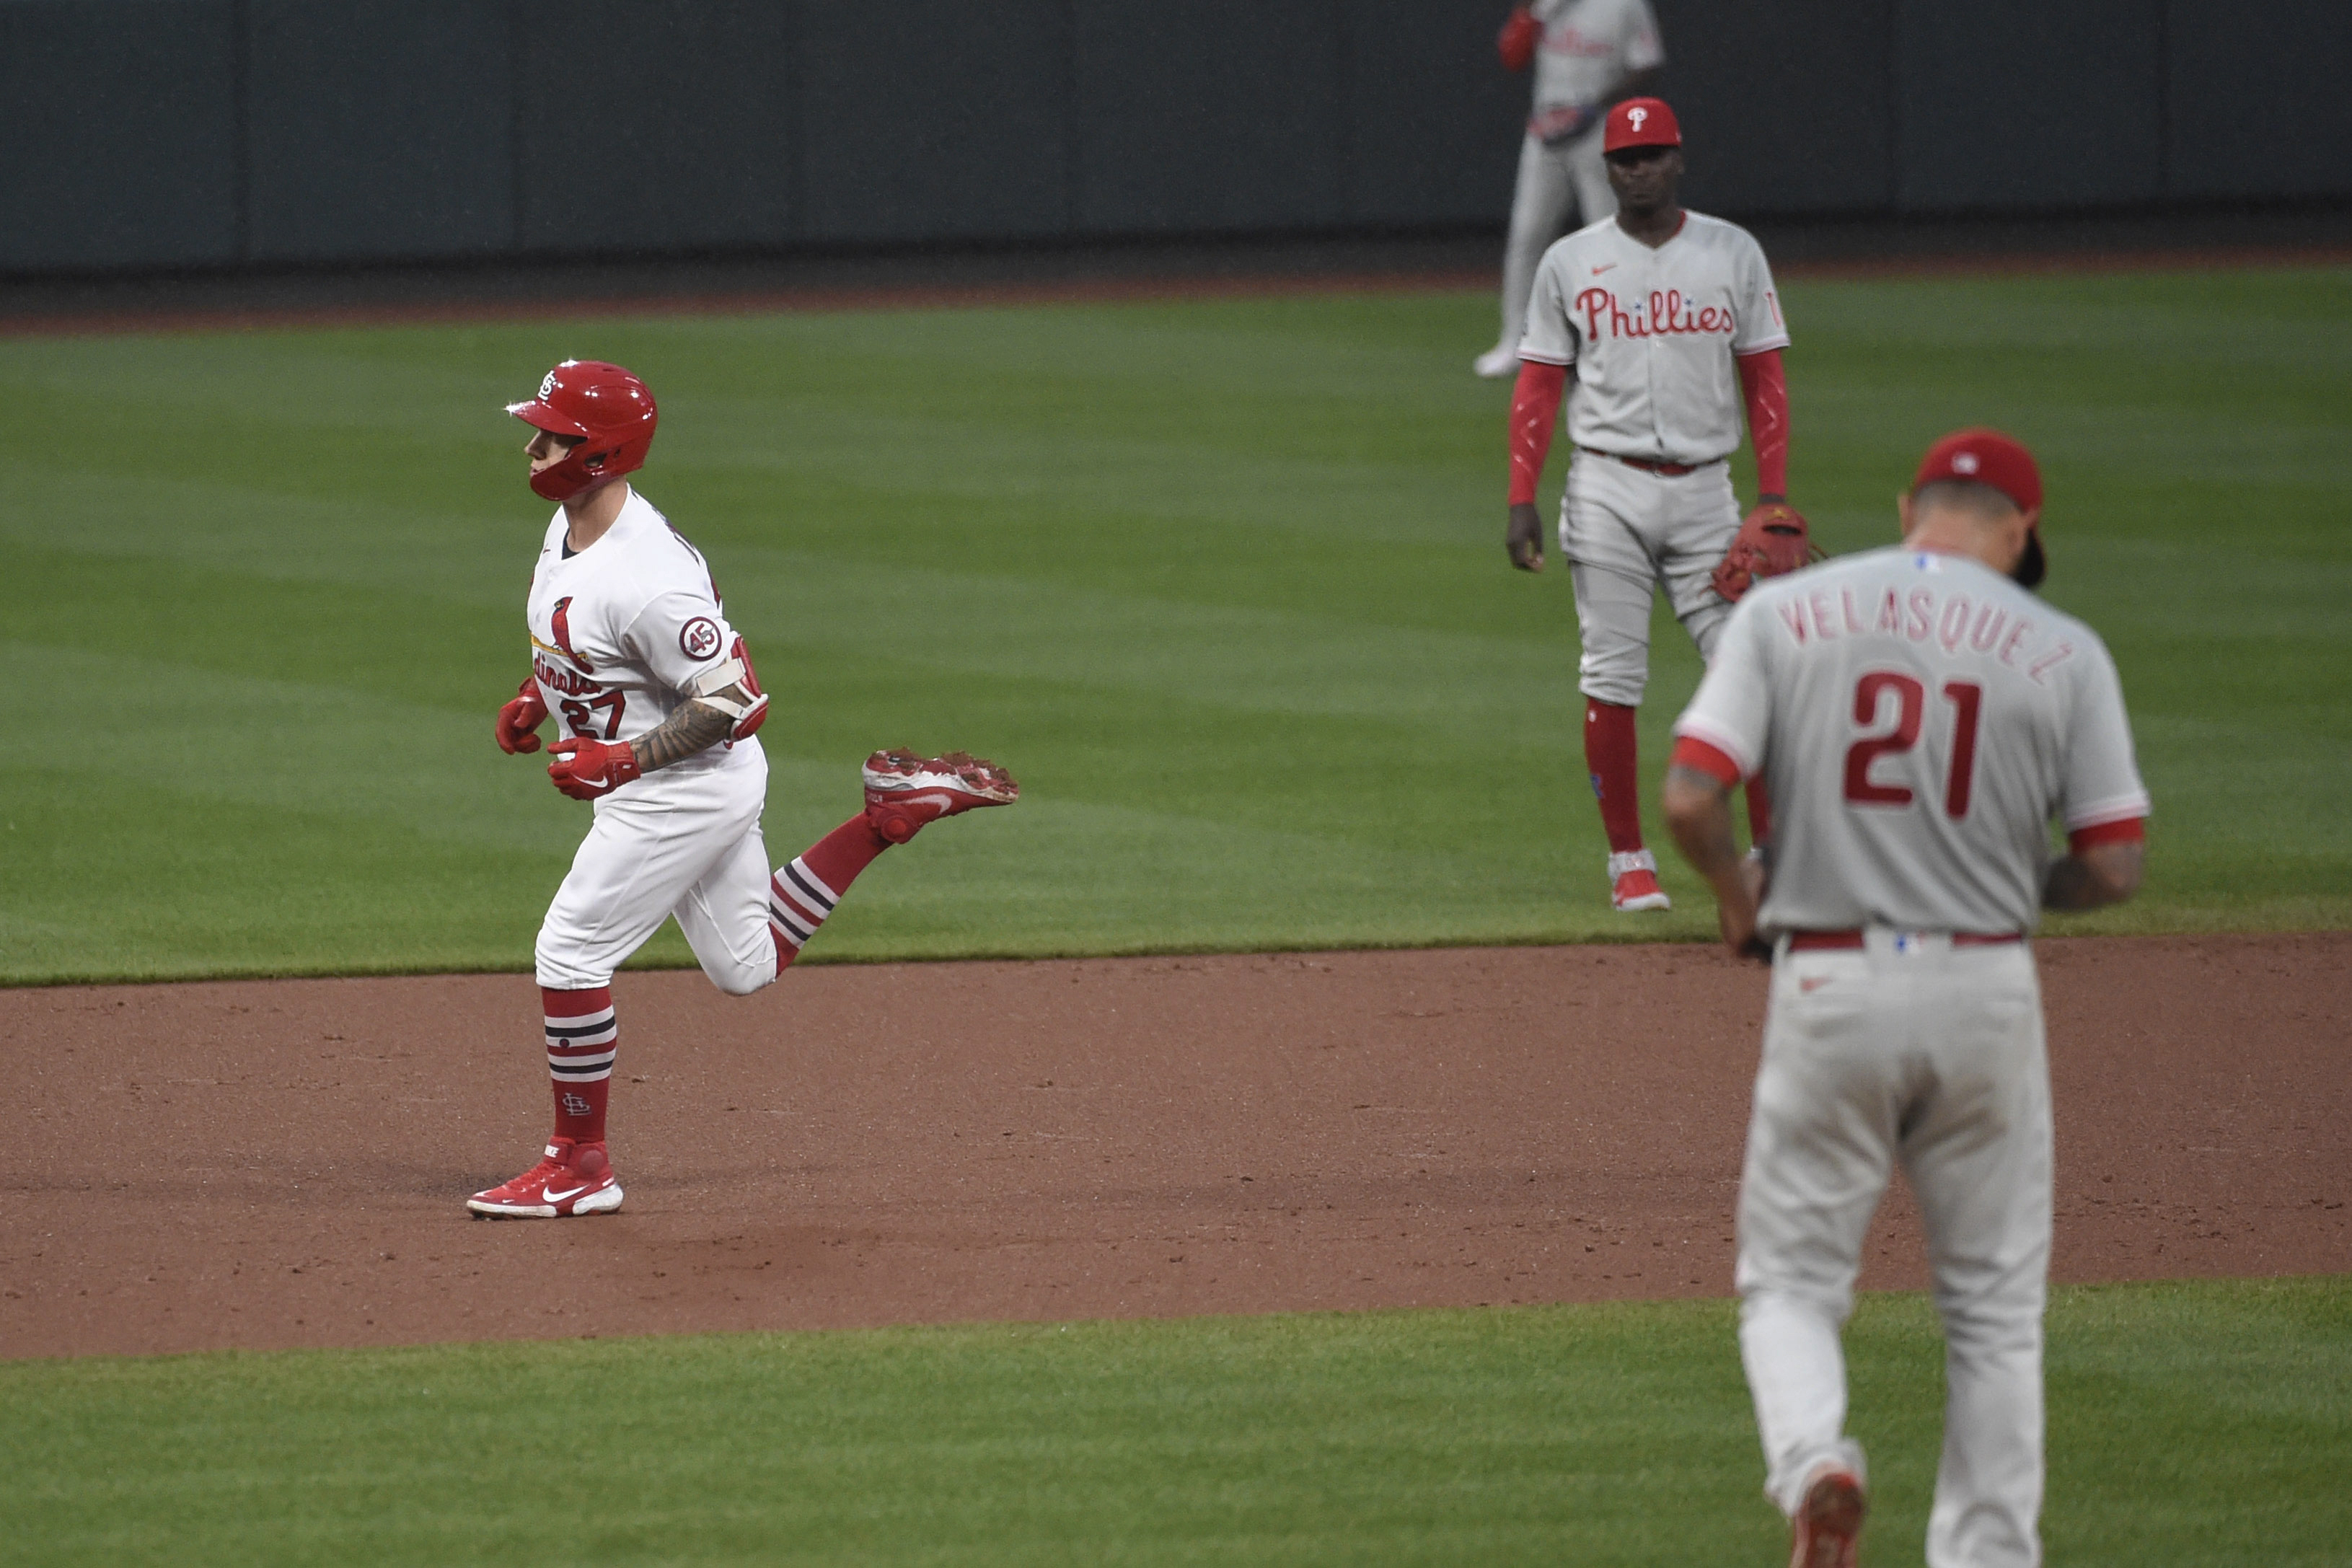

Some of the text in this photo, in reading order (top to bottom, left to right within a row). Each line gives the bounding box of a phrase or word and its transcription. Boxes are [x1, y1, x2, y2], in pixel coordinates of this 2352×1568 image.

[1627, 107, 1647, 132] P
[1575, 287, 1732, 340] Phillies
[690, 622, 715, 653] 45
[1777, 588, 2073, 685] VELASQUEZ
[560, 690, 626, 740] 27
[1842, 671, 1981, 821] 21
